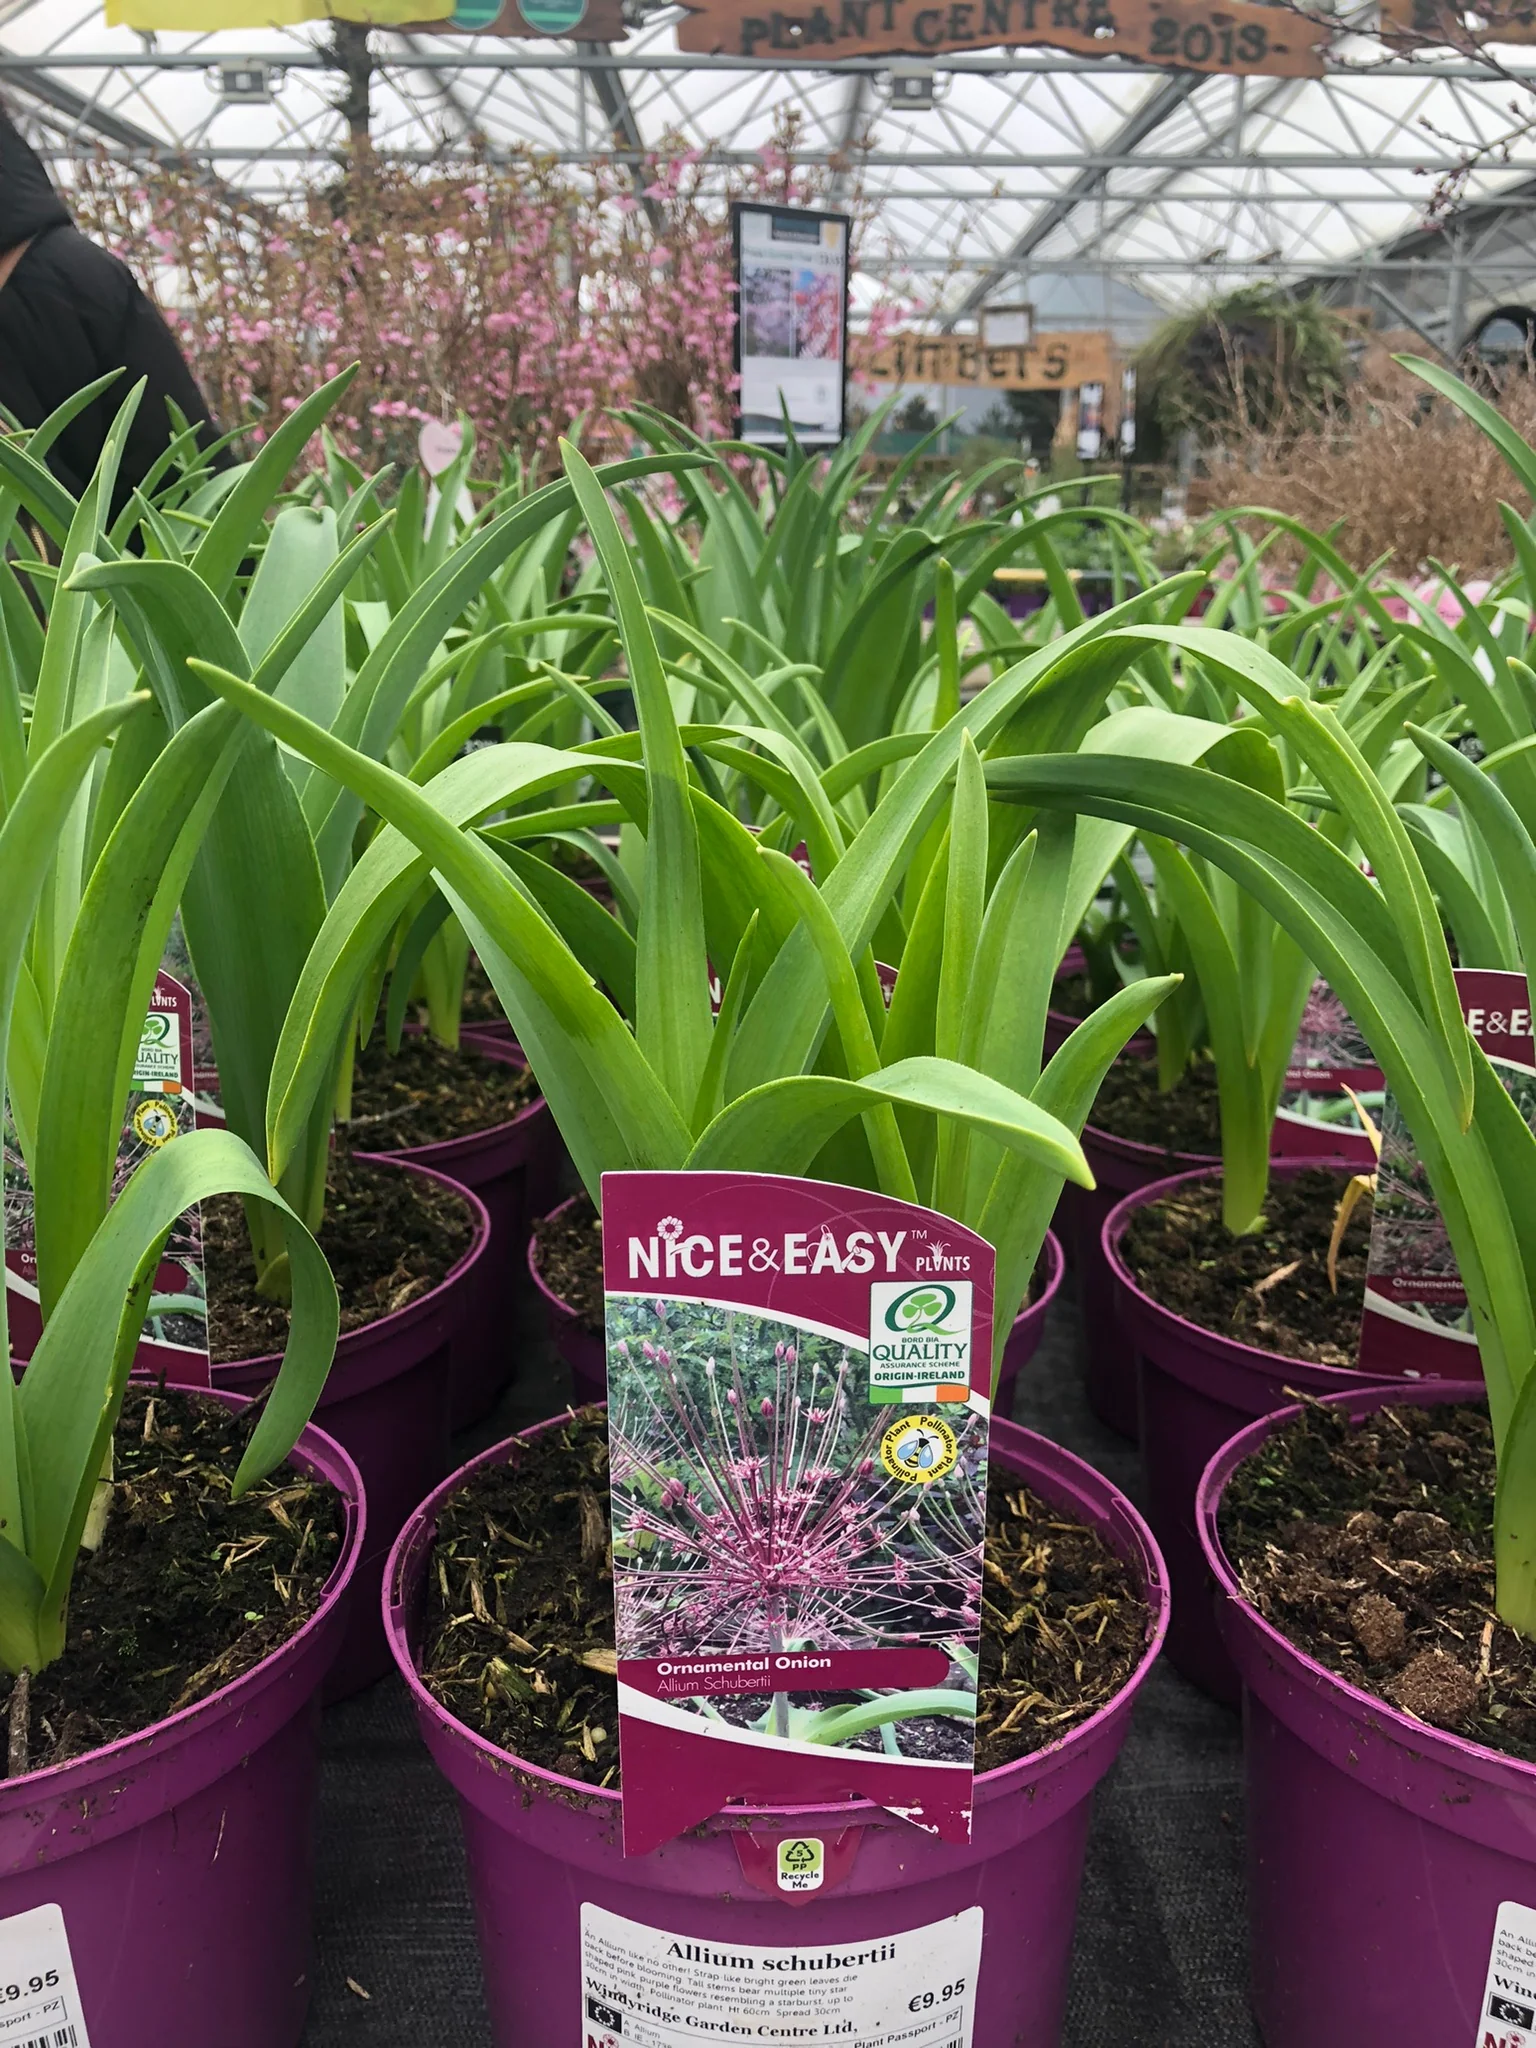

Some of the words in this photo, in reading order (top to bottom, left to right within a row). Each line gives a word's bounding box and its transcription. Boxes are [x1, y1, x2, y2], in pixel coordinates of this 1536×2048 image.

[740, 0, 908, 56] PLANT
[912, 0, 1118, 46] CENTRE
[151, 996, 177, 1008] LANTS
[136, 1052, 179, 1065] UALITY
[1392, 1277, 1465, 1289] Ornamenta
[901, 1336, 924, 1344] BORD
[872, 1342, 968, 1362] QUALITY
[874, 1370, 966, 1381] ORIGIN-IRELAND
[885, 1420, 911, 1442] Plant
[919, 1416, 954, 1454] Pollinator
[884, 1444, 918, 1482] Pollinator
[927, 1457, 953, 1478] Plant
[656, 1657, 770, 1676] Ornamental
[775, 1655, 832, 1670] Onion
[656, 1677, 699, 1693] Allium
[703, 1675, 771, 1691] Schubertii
[781, 1870, 820, 1881] Recycle
[792, 1863, 807, 1871] PP
[792, 1880, 809, 1889] Me
[1500, 1929, 1515, 1940] An
[1498, 1938, 1523, 1954] back
[584, 1930, 596, 1941] An
[598, 1938, 626, 1955] Allium
[628, 1950, 645, 1962] like
[646, 1957, 660, 1967] no
[661, 1962, 691, 1975] other!
[744, 1976, 775, 1988] bright
[777, 1979, 807, 1989] green
[809, 1976, 840, 1986] leaves
[842, 1973, 858, 1983] die
[666, 1942, 755, 1970] Allium
[762, 1942, 896, 1972] schubertii
[1495, 1957, 1523, 1974] 30cm
[1496, 1949, 1535, 1968] shaped
[584, 1941, 604, 1954] back
[606, 1952, 635, 1968] before
[687, 1977, 705, 1989] Tall
[706, 1983, 736, 1993] stems
[738, 1986, 761, 1995] bear
[764, 1987, 806, 1997] multiple
[808, 1987, 828, 1997] tiny
[584, 1951, 615, 1970] shaped
[616, 1966, 636, 1979] pink
[639, 1976, 670, 1991] purple
[672, 1985, 708, 2000] flowers
[710, 1993, 766, 2008] resembling
[827, 1997, 841, 2005] up
[843, 1995, 854, 2003] to
[585, 1960, 607, 1977] 30cm
[609, 1971, 618, 1981] in
[650, 1988, 696, 2006] Pollinator
[728, 2004, 740, 2014] Ht
[742, 2007, 771, 2016] 60cm
[776, 2008, 811, 2018] Spread
[814, 2007, 841, 2016] 30cm
[908, 1978, 966, 2013] €9.95
[43, 2000, 60, 2014] PZ
[585, 1976, 682, 2024] Windyridge
[685, 2015, 753, 2036] Garden
[757, 2024, 818, 2037] Centre
[854, 2037, 884, 2048] Plant
[887, 2022, 937, 2043] Passport
[945, 2010, 960, 2023] PZ
